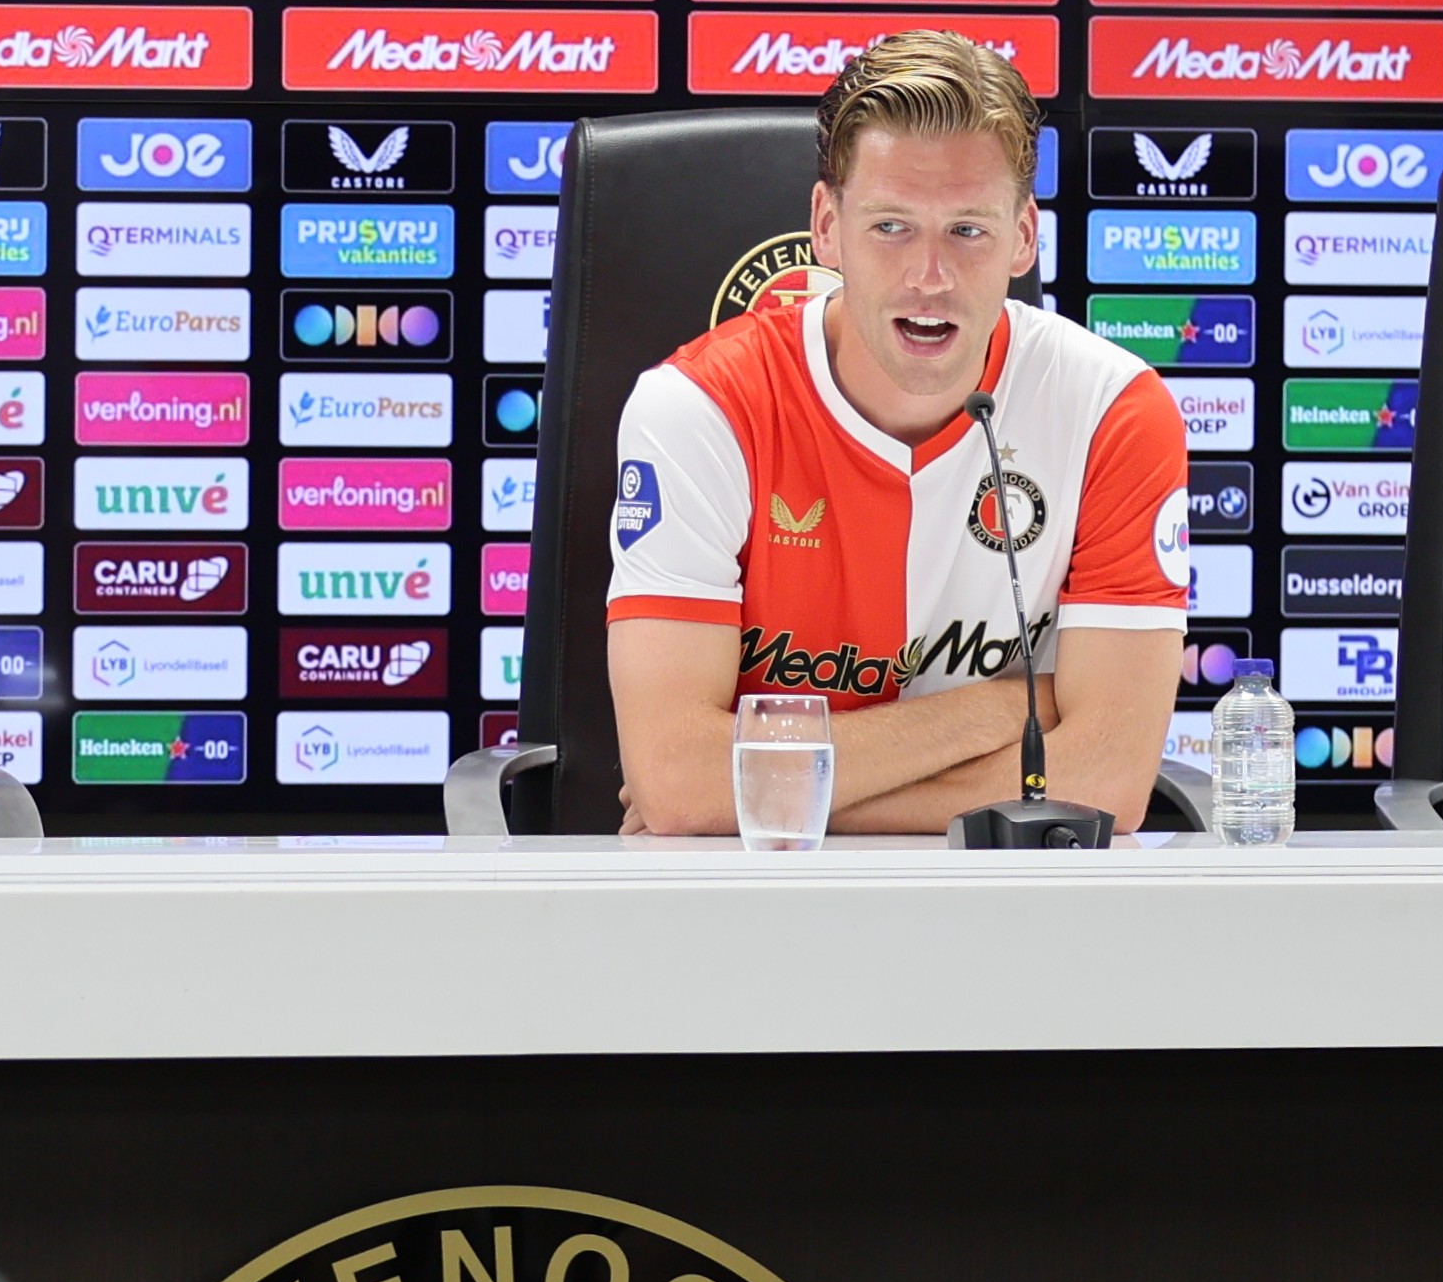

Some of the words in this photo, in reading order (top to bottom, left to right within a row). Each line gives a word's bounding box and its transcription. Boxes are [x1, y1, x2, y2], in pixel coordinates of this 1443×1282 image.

[99, 132, 225, 177] JOE
[1306, 142, 1427, 187] JOE
[331, 177, 404, 189] CASTORE
[1136, 184, 1207, 195] CASTORE
[87, 225, 240, 249] QTERMINALS
[337, 245, 437, 263] vakanties
[1142, 251, 1239, 269] vakanties
[115, 310, 240, 332] EuroParcs
[1094, 322, 1175, 339] Heineken
[83, 390, 241, 428] verloning.nl
[318, 396, 443, 417] EuroParcs
[1290, 407, 1370, 424] Heineken
[95, 473, 229, 514] univé
[286, 475, 444, 512] verloning.nl
[93, 560, 178, 584] CARU
[298, 558, 431, 598] univé
[96, 586, 175, 596] CONTAINERS
[297, 645, 381, 668] CARU
[299, 671, 378, 680] CONTAINERS
[80, 739, 163, 756] Heineken
